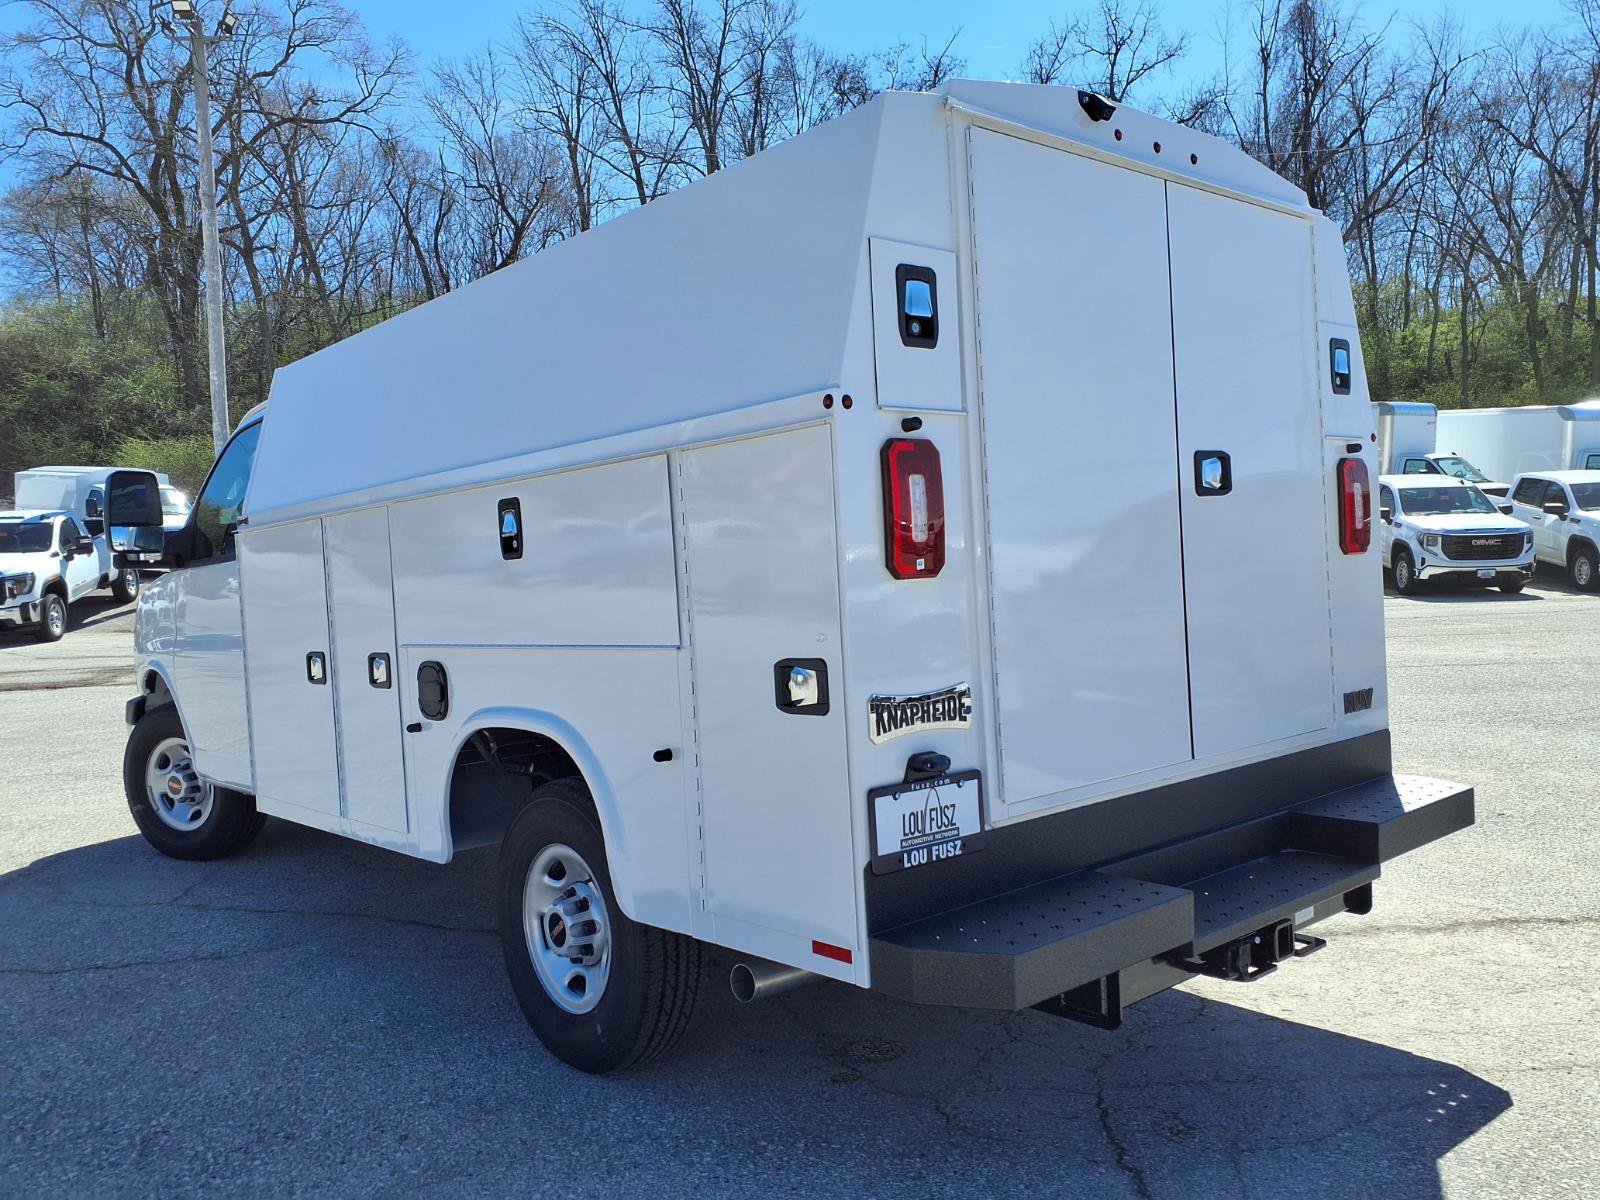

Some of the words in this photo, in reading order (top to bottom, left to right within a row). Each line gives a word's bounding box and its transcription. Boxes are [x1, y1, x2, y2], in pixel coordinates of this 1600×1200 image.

[875, 692, 967, 737] KNAPHEIDE
[911, 779, 950, 790] fusz.com
[902, 810, 923, 837] LOU
[929, 803, 956, 831] FUSZ
[901, 836, 933, 847] AUTOMOTIVE
[935, 830, 959, 840] NETWORK
[903, 848, 928, 868] LOU
[932, 840, 962, 861] FUSZ
